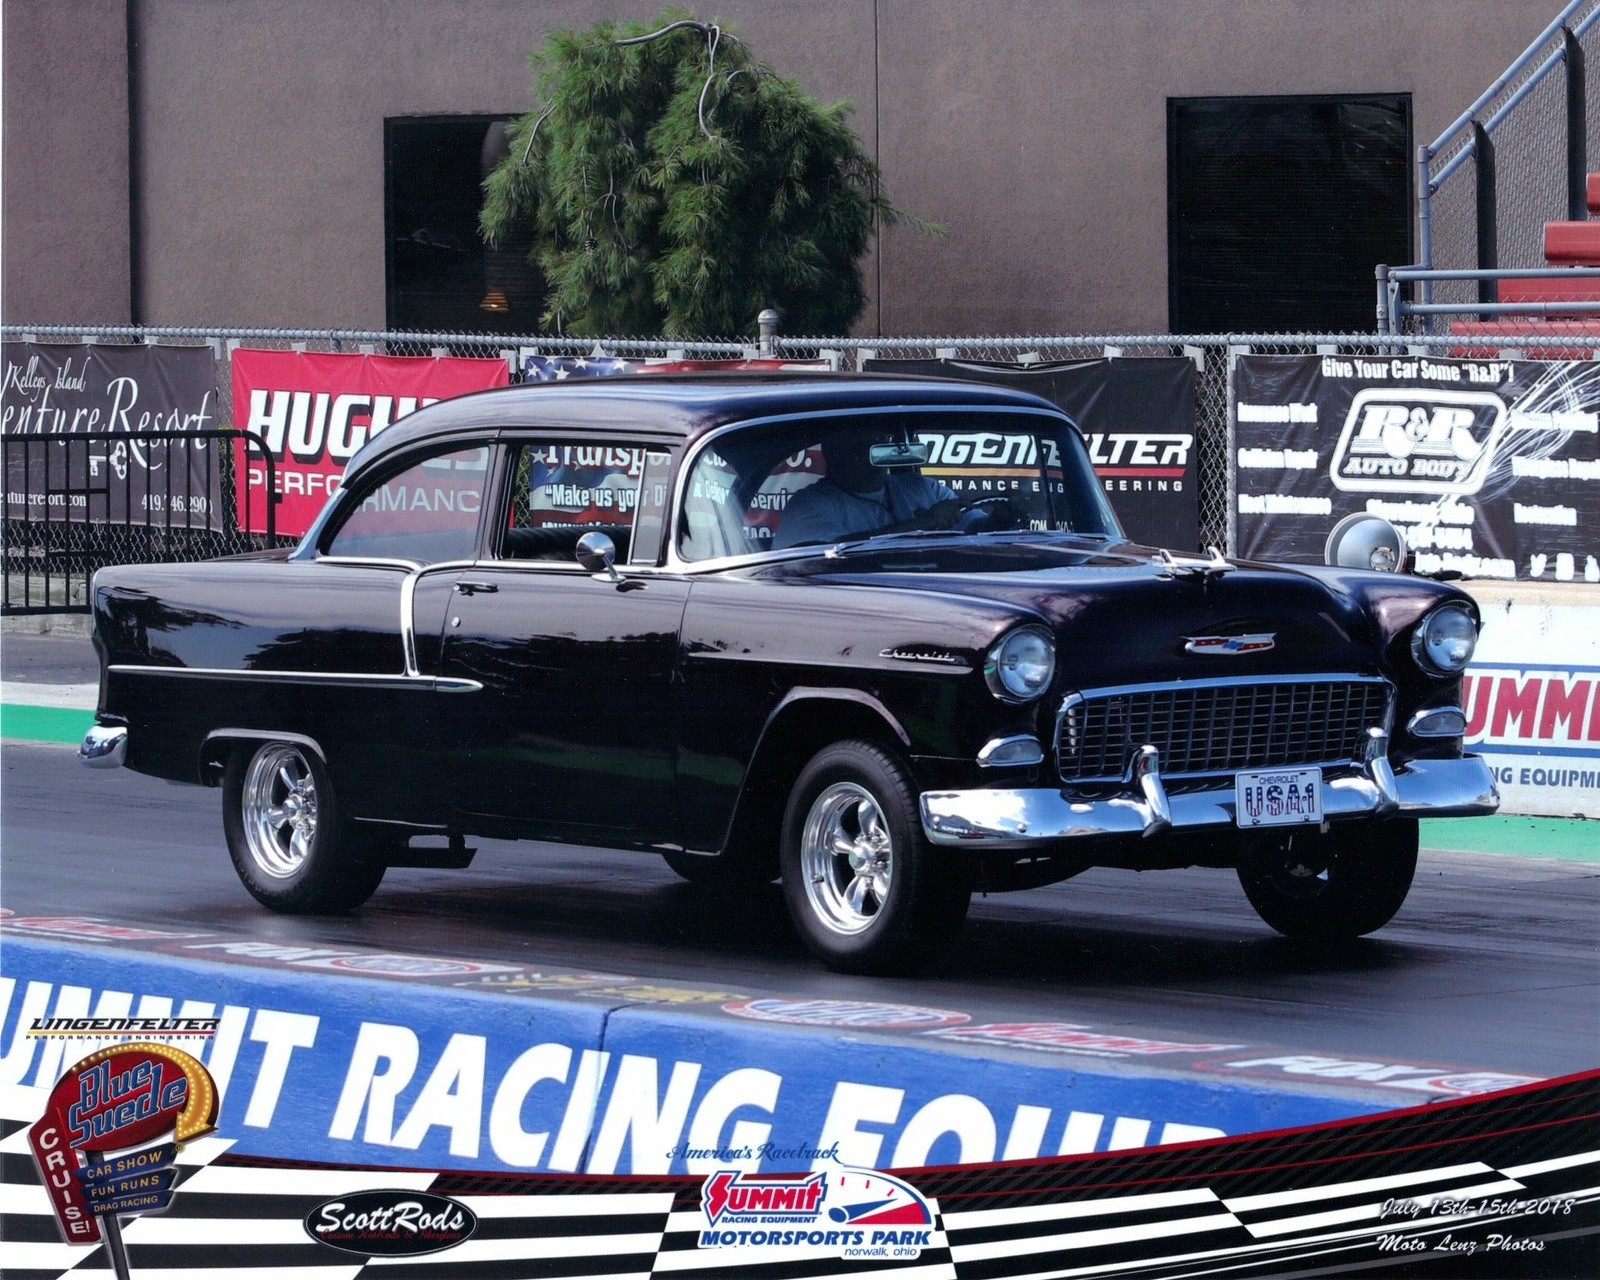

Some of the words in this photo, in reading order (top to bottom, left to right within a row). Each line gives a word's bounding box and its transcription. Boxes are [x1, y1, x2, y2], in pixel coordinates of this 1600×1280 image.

[1322, 358, 1353, 378] Give
[1355, 359, 1388, 379] Your
[1391, 360, 1418, 379] Car
[1420, 360, 1461, 382] Some
[1350, 404, 1483, 459] R&R
[1343, 457, 1408, 475] AUTO
[1410, 458, 1472, 478] BODY
[595, 488, 613, 507] us
[1259, 775, 1299, 785] CHEVROLET
[1520, 768, 1600, 788] EQUIPM
[328, 1021, 783, 1174] RACING
